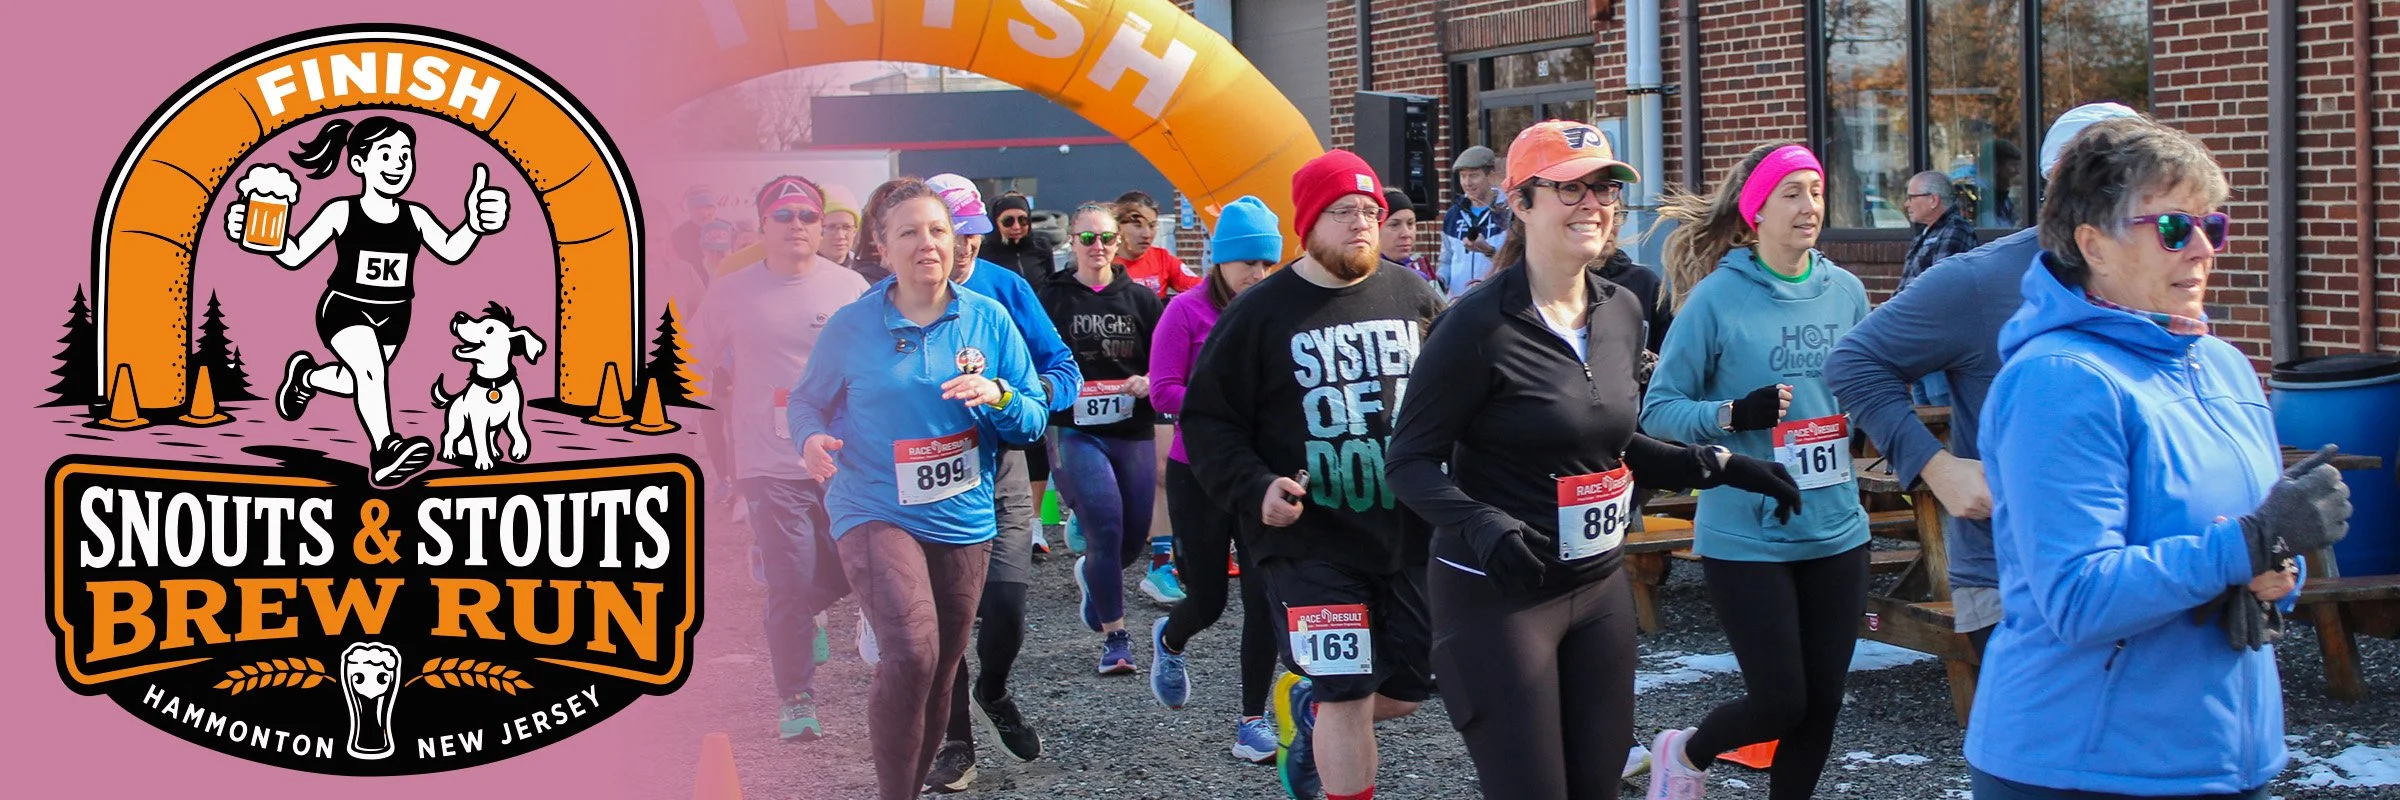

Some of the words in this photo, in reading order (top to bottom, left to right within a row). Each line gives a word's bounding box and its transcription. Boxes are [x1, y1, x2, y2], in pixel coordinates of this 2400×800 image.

[1781, 323, 1838, 351] HOT
[1087, 396, 1120, 416] 871
[1302, 380, 1385, 438] OF
[908, 446, 932, 456] RACE
[1796, 443, 1837, 475] 161
[917, 457, 964, 491] 899
[1576, 483, 1603, 496] RACE
[1332, 612, 1362, 623] RESULT
[1308, 632, 1359, 661] 163
